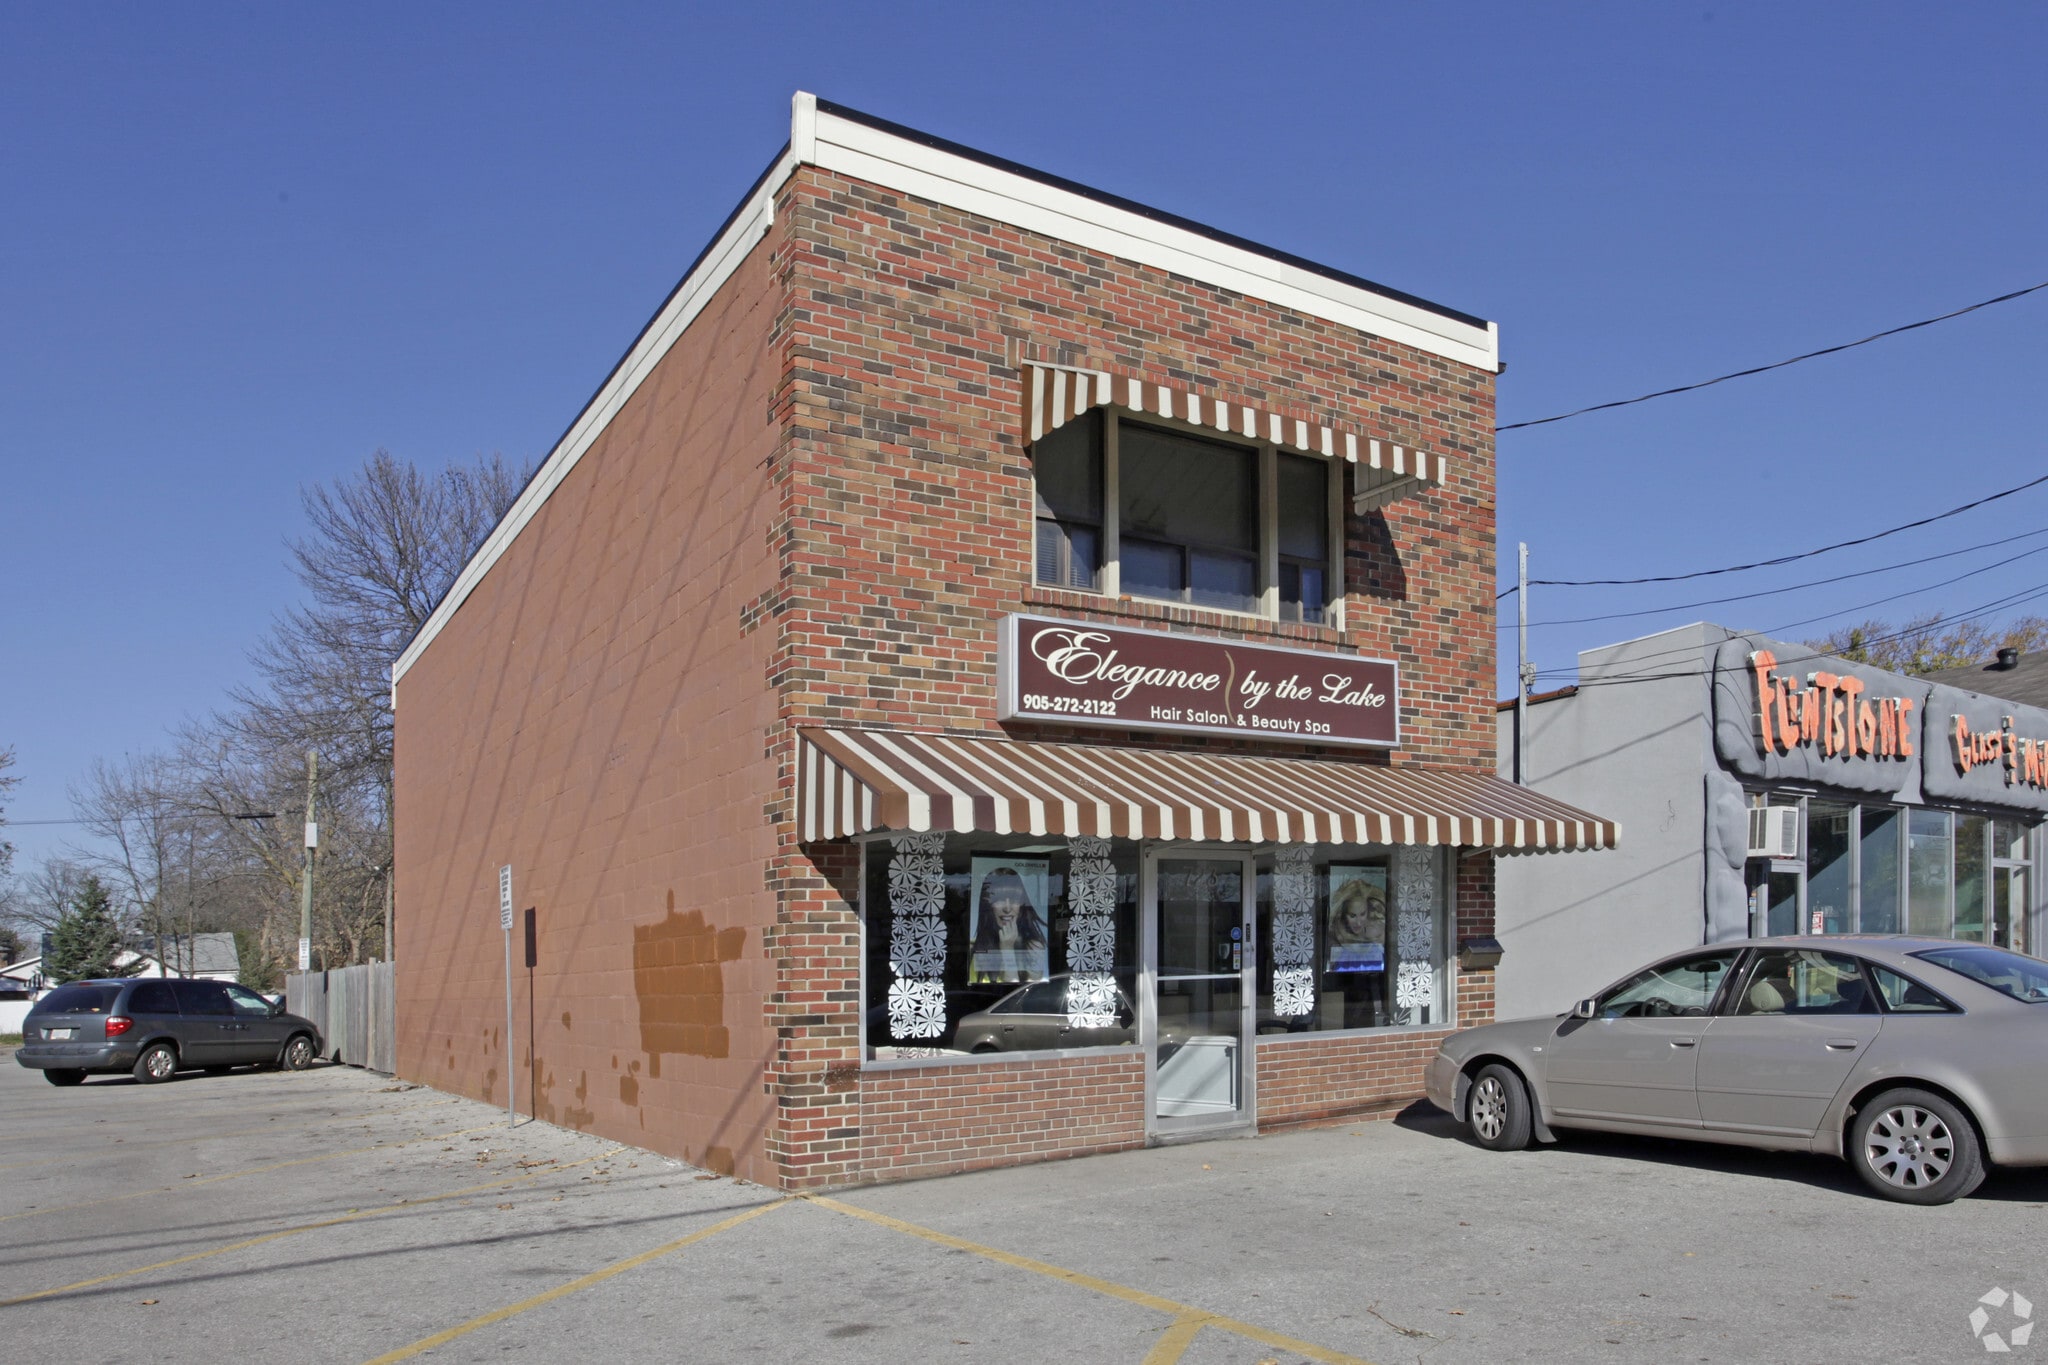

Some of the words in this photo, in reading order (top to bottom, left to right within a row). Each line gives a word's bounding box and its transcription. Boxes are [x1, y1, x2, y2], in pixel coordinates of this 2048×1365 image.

[1031, 627, 1221, 701] Elegance
[1240, 670, 1271, 709] by
[1275, 675, 1312, 700] the
[1318, 673, 1386, 708] Lake
[1022, 693, 1117, 716] 905-272-2122
[1150, 705, 1182, 721] Hair
[1186, 708, 1228, 725] Salon
[1236, 713, 1247, 727] &
[1252, 714, 1301, 734] Beauty
[1305, 719, 1331, 735] Spa
